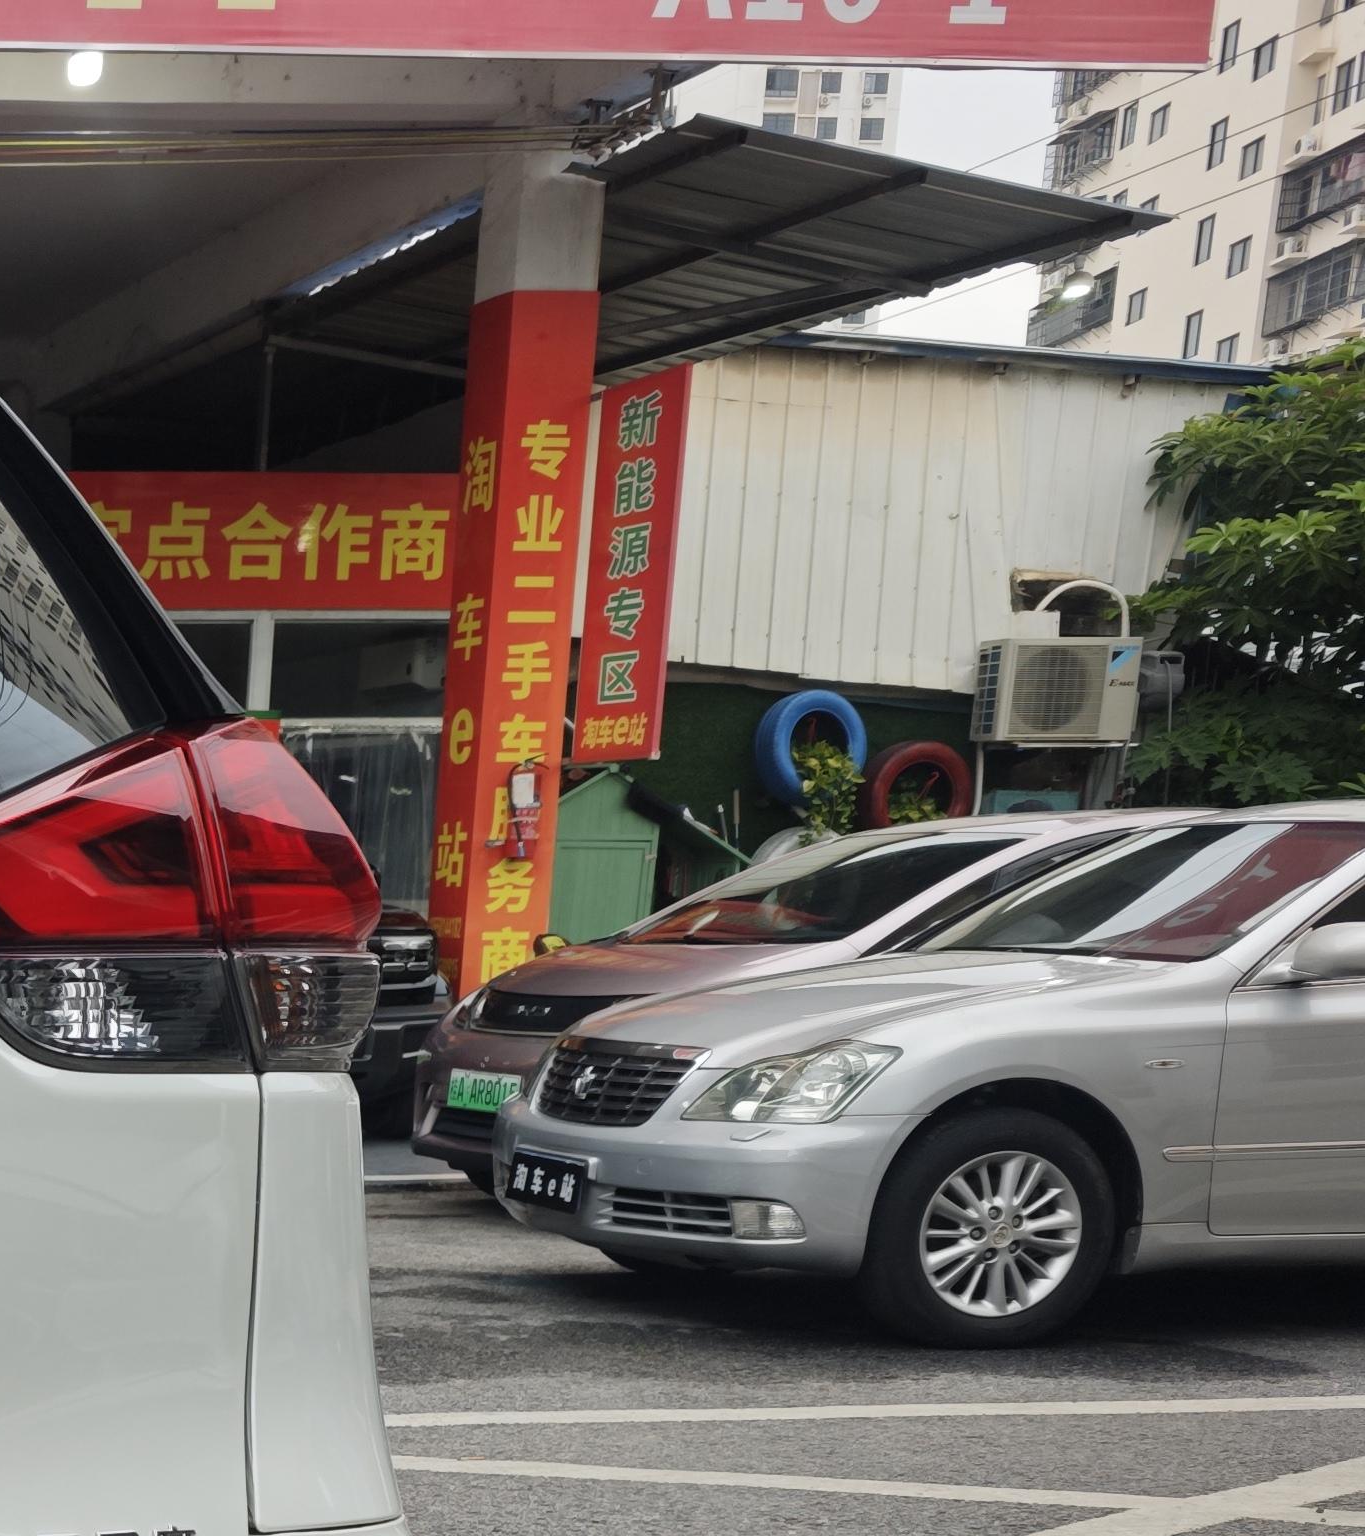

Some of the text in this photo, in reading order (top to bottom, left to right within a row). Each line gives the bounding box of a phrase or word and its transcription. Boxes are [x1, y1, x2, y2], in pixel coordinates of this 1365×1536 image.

[596, 389, 663, 706] 新能源专区
[435, 436, 498, 888] 淘车e站
[580, 711, 649, 750] 淘车e站
[512, 1163, 577, 1203] 淘车e站
